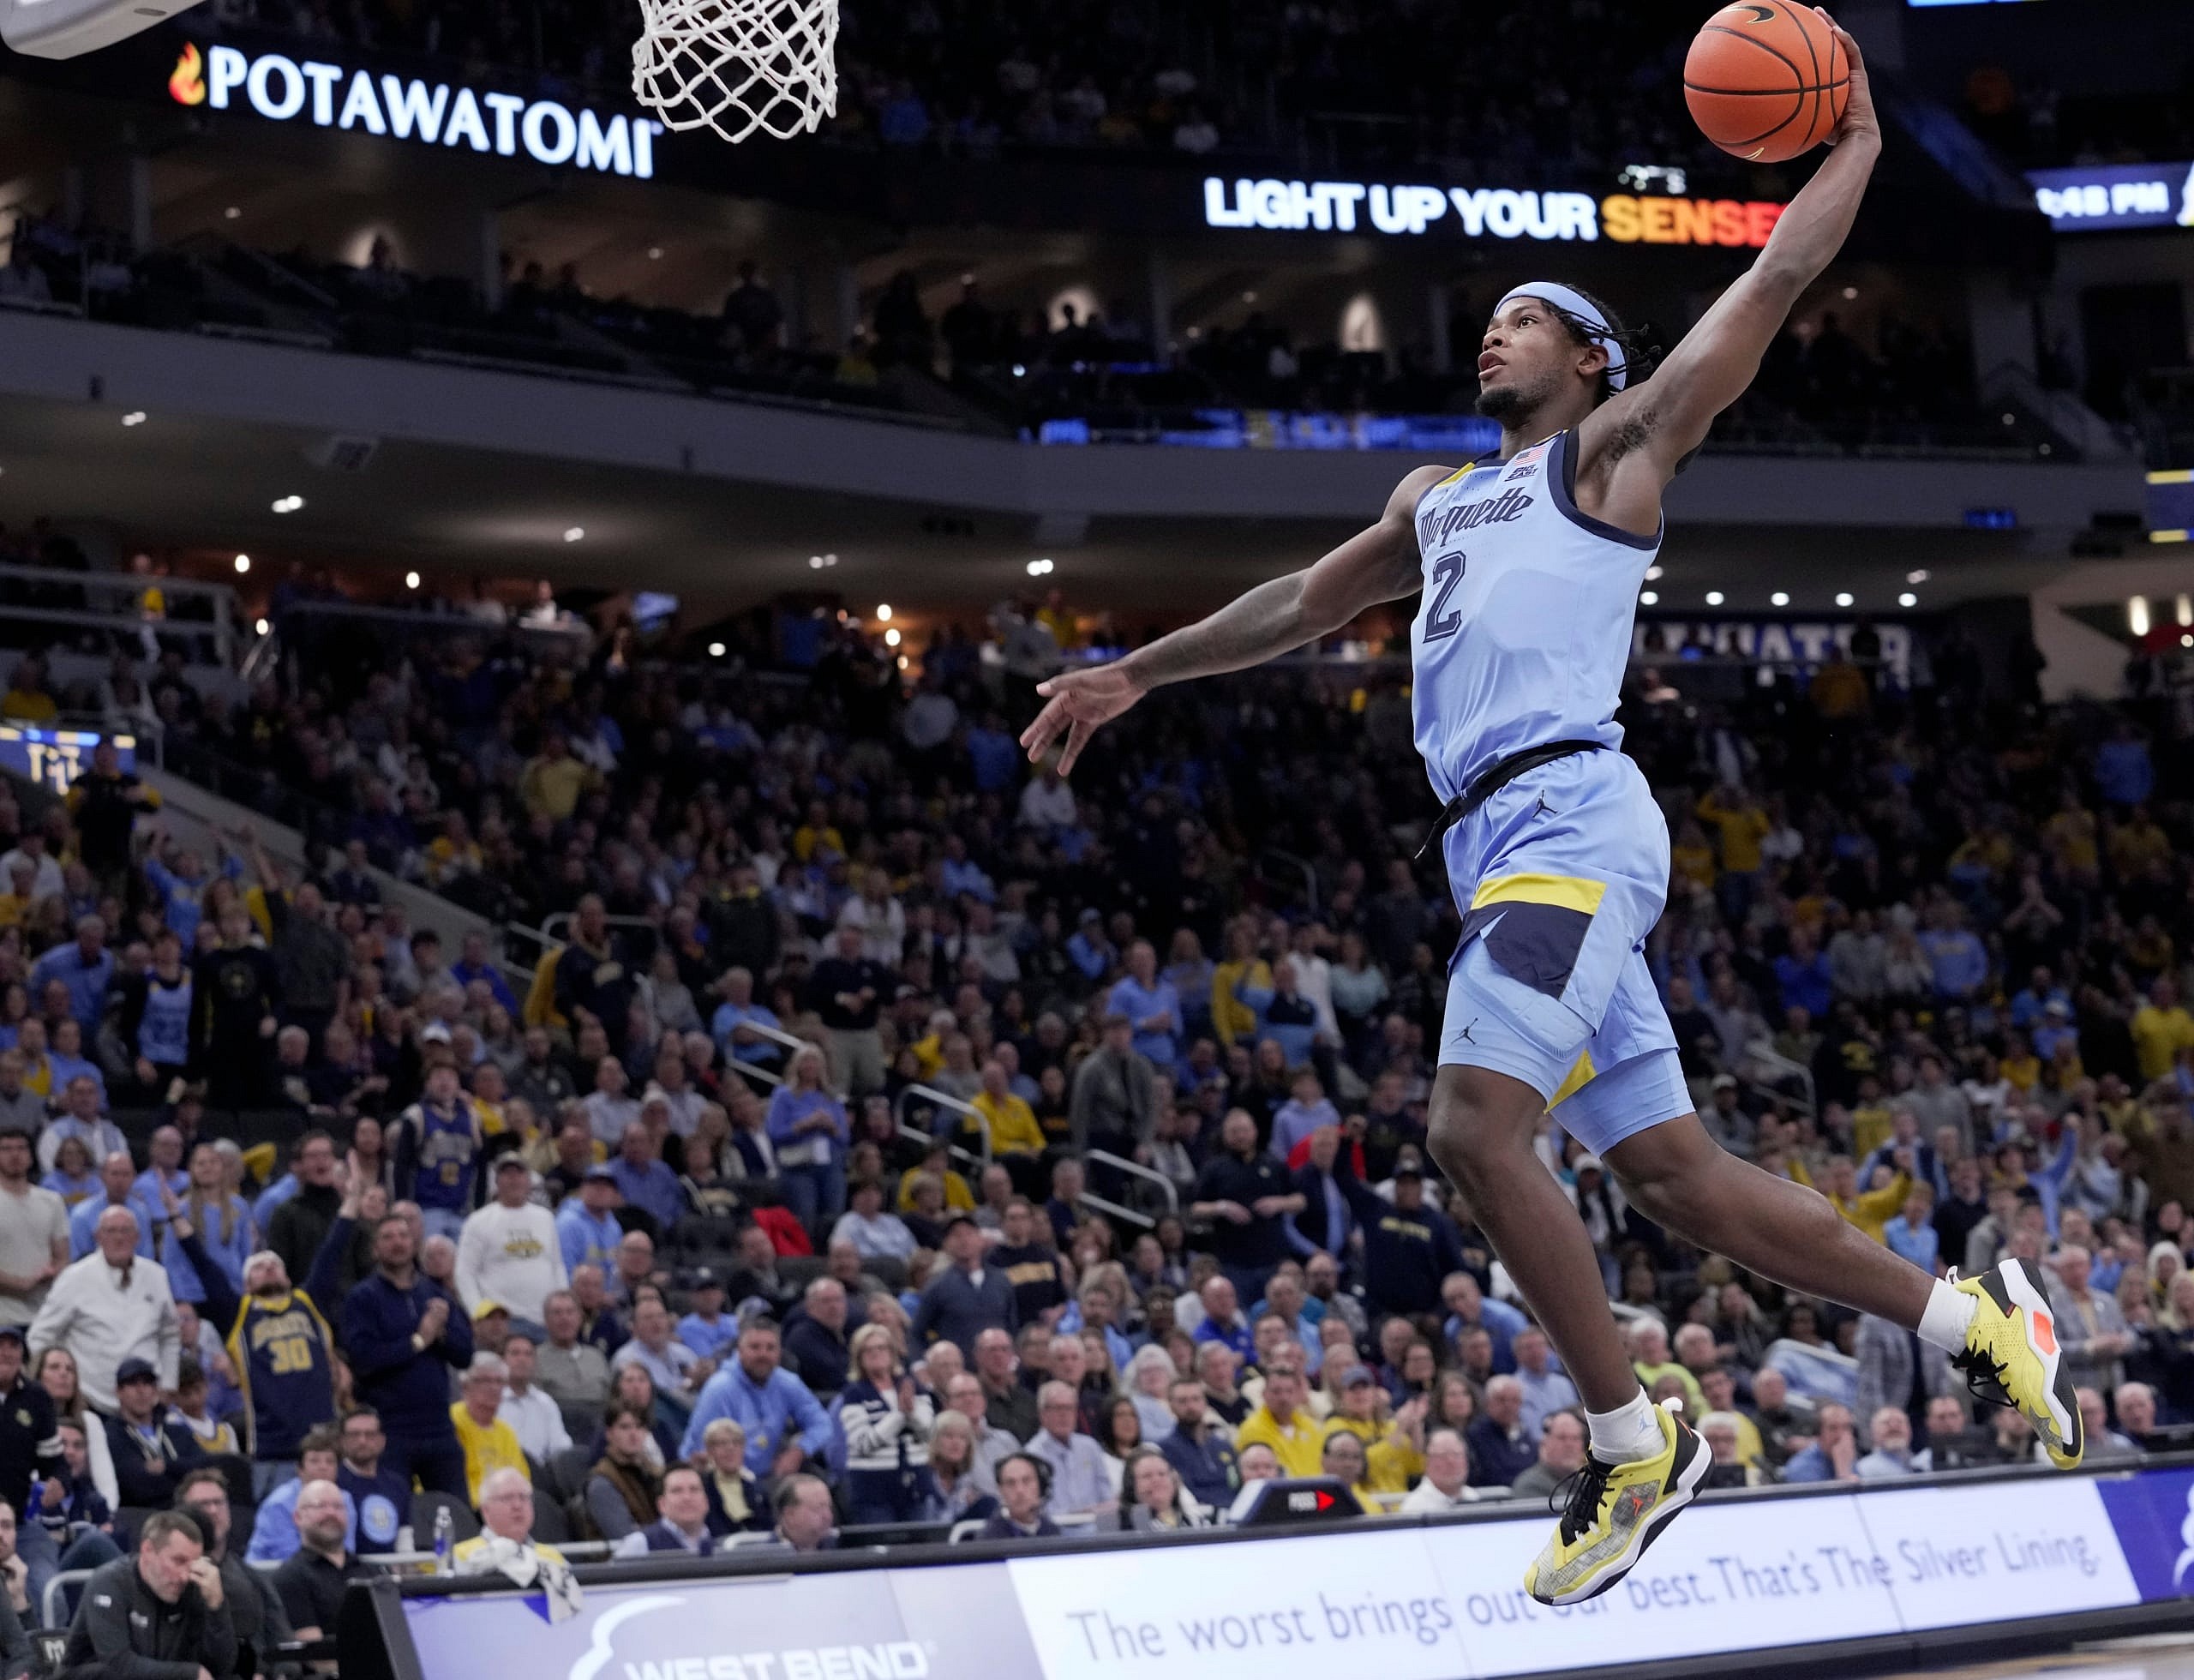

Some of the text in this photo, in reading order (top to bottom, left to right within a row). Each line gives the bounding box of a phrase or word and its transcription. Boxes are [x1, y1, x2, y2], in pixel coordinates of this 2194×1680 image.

[208, 45, 654, 179] POTAWATOMI
[1203, 177, 1791, 248] LIGHT UP YOUR SENSE
[2111, 181, 2169, 215] PM
[1423, 550, 1466, 644] 2
[268, 1336, 313, 1376] 30
[1065, 1609, 1167, 1661] The
[1178, 1607, 1316, 1653] worst
[1317, 1590, 1455, 1646] brings
[1466, 1590, 1538, 1626] out
[1707, 1548, 1822, 1601] That's
[1818, 1544, 1896, 1587] The
[1897, 1538, 1988, 1582] Silver
[780, 1641, 929, 1680] BEND
